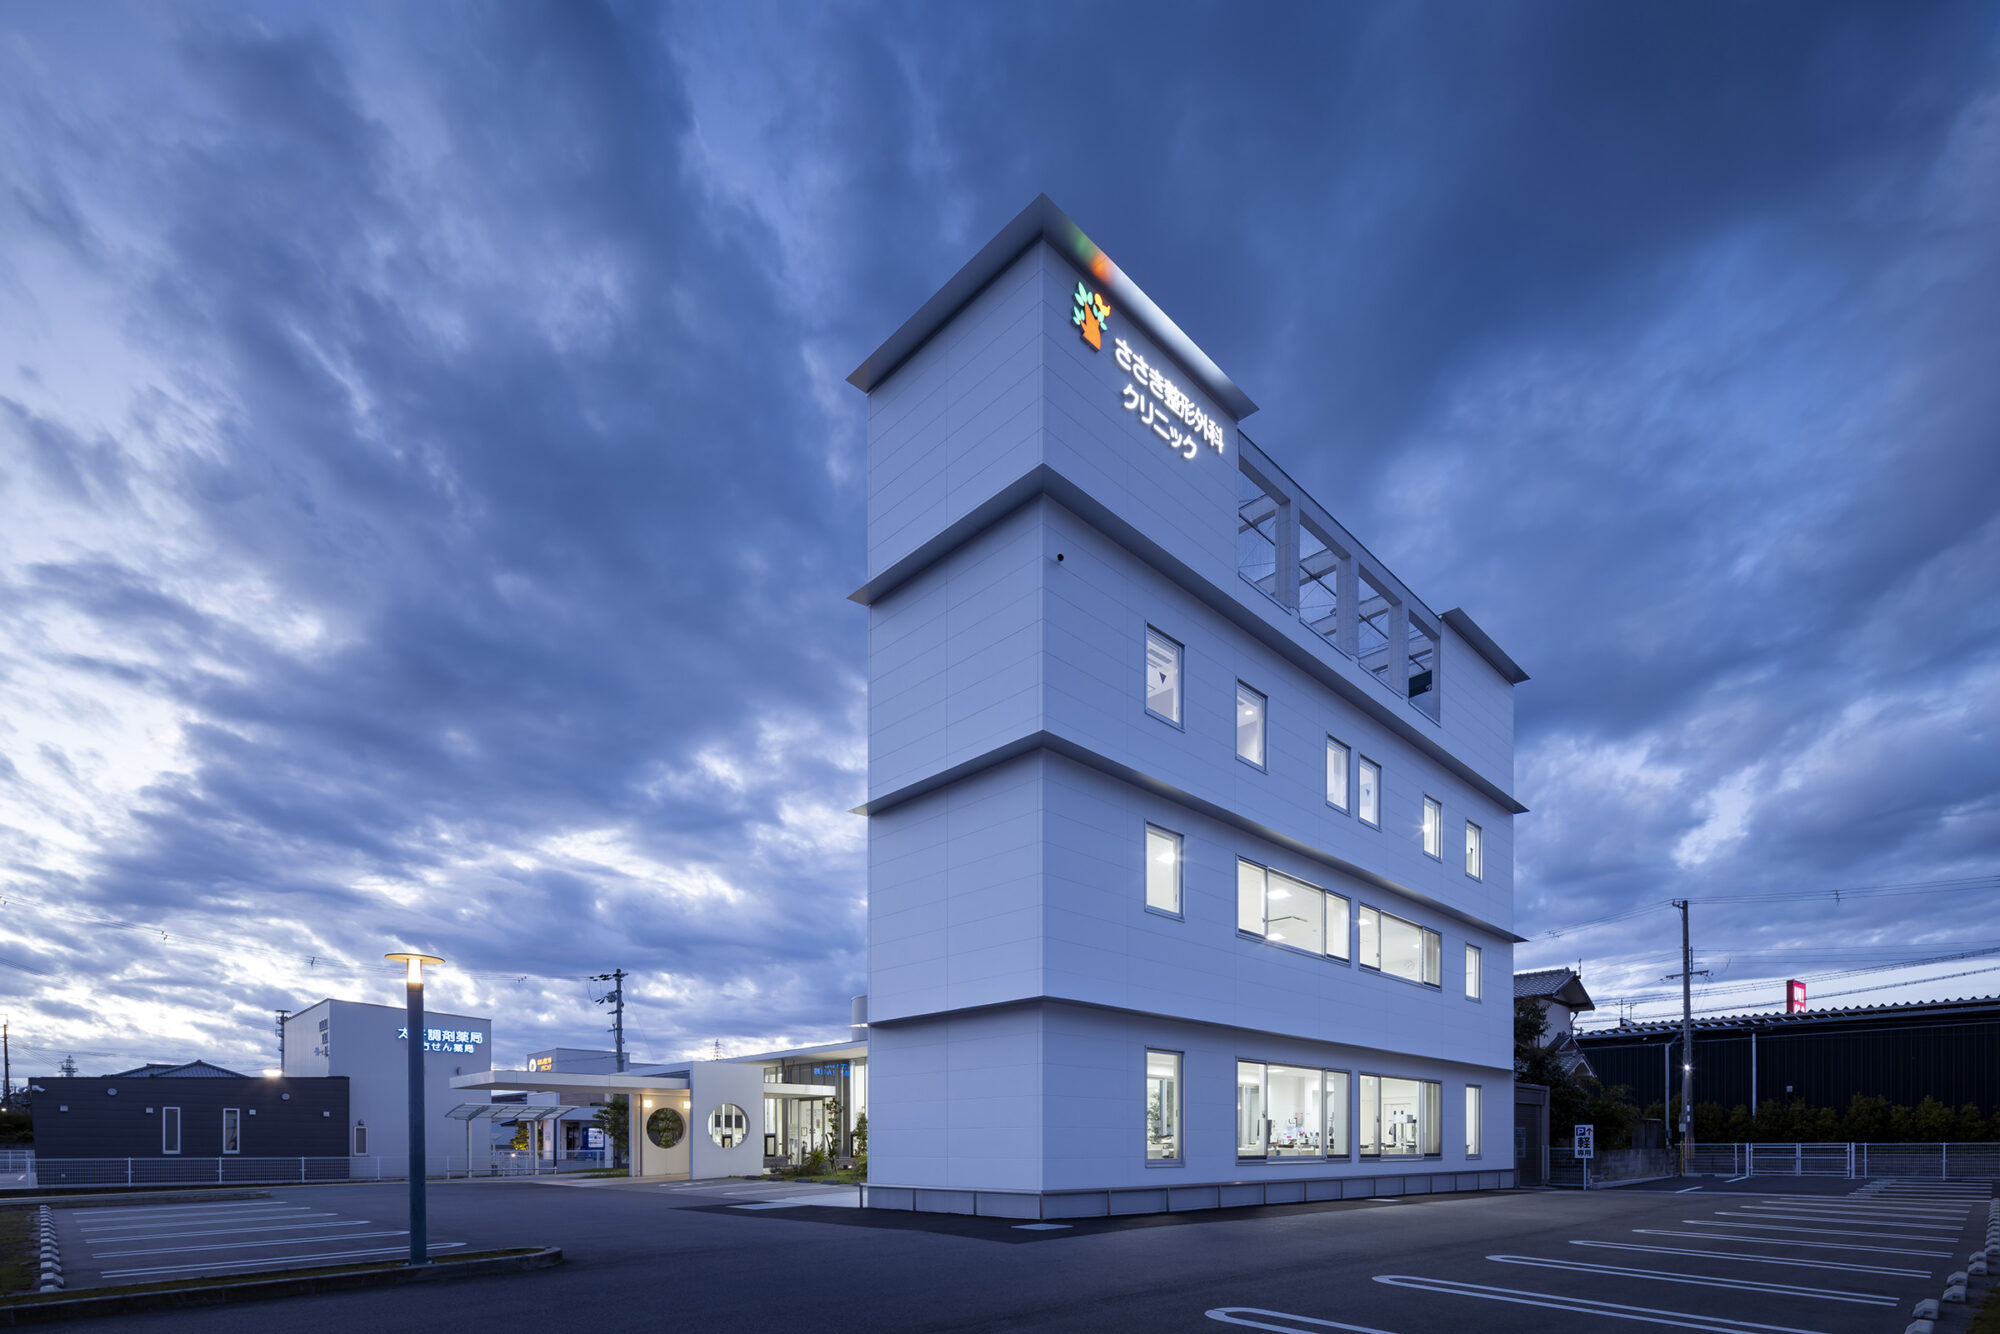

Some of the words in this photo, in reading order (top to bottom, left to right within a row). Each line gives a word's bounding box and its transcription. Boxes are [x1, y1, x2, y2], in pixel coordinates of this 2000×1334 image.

[1114, 337, 1224, 454] ささき整形外科
[1122, 384, 1198, 459] クリニック
[397, 1027, 483, 1044] 太調剤薬局
